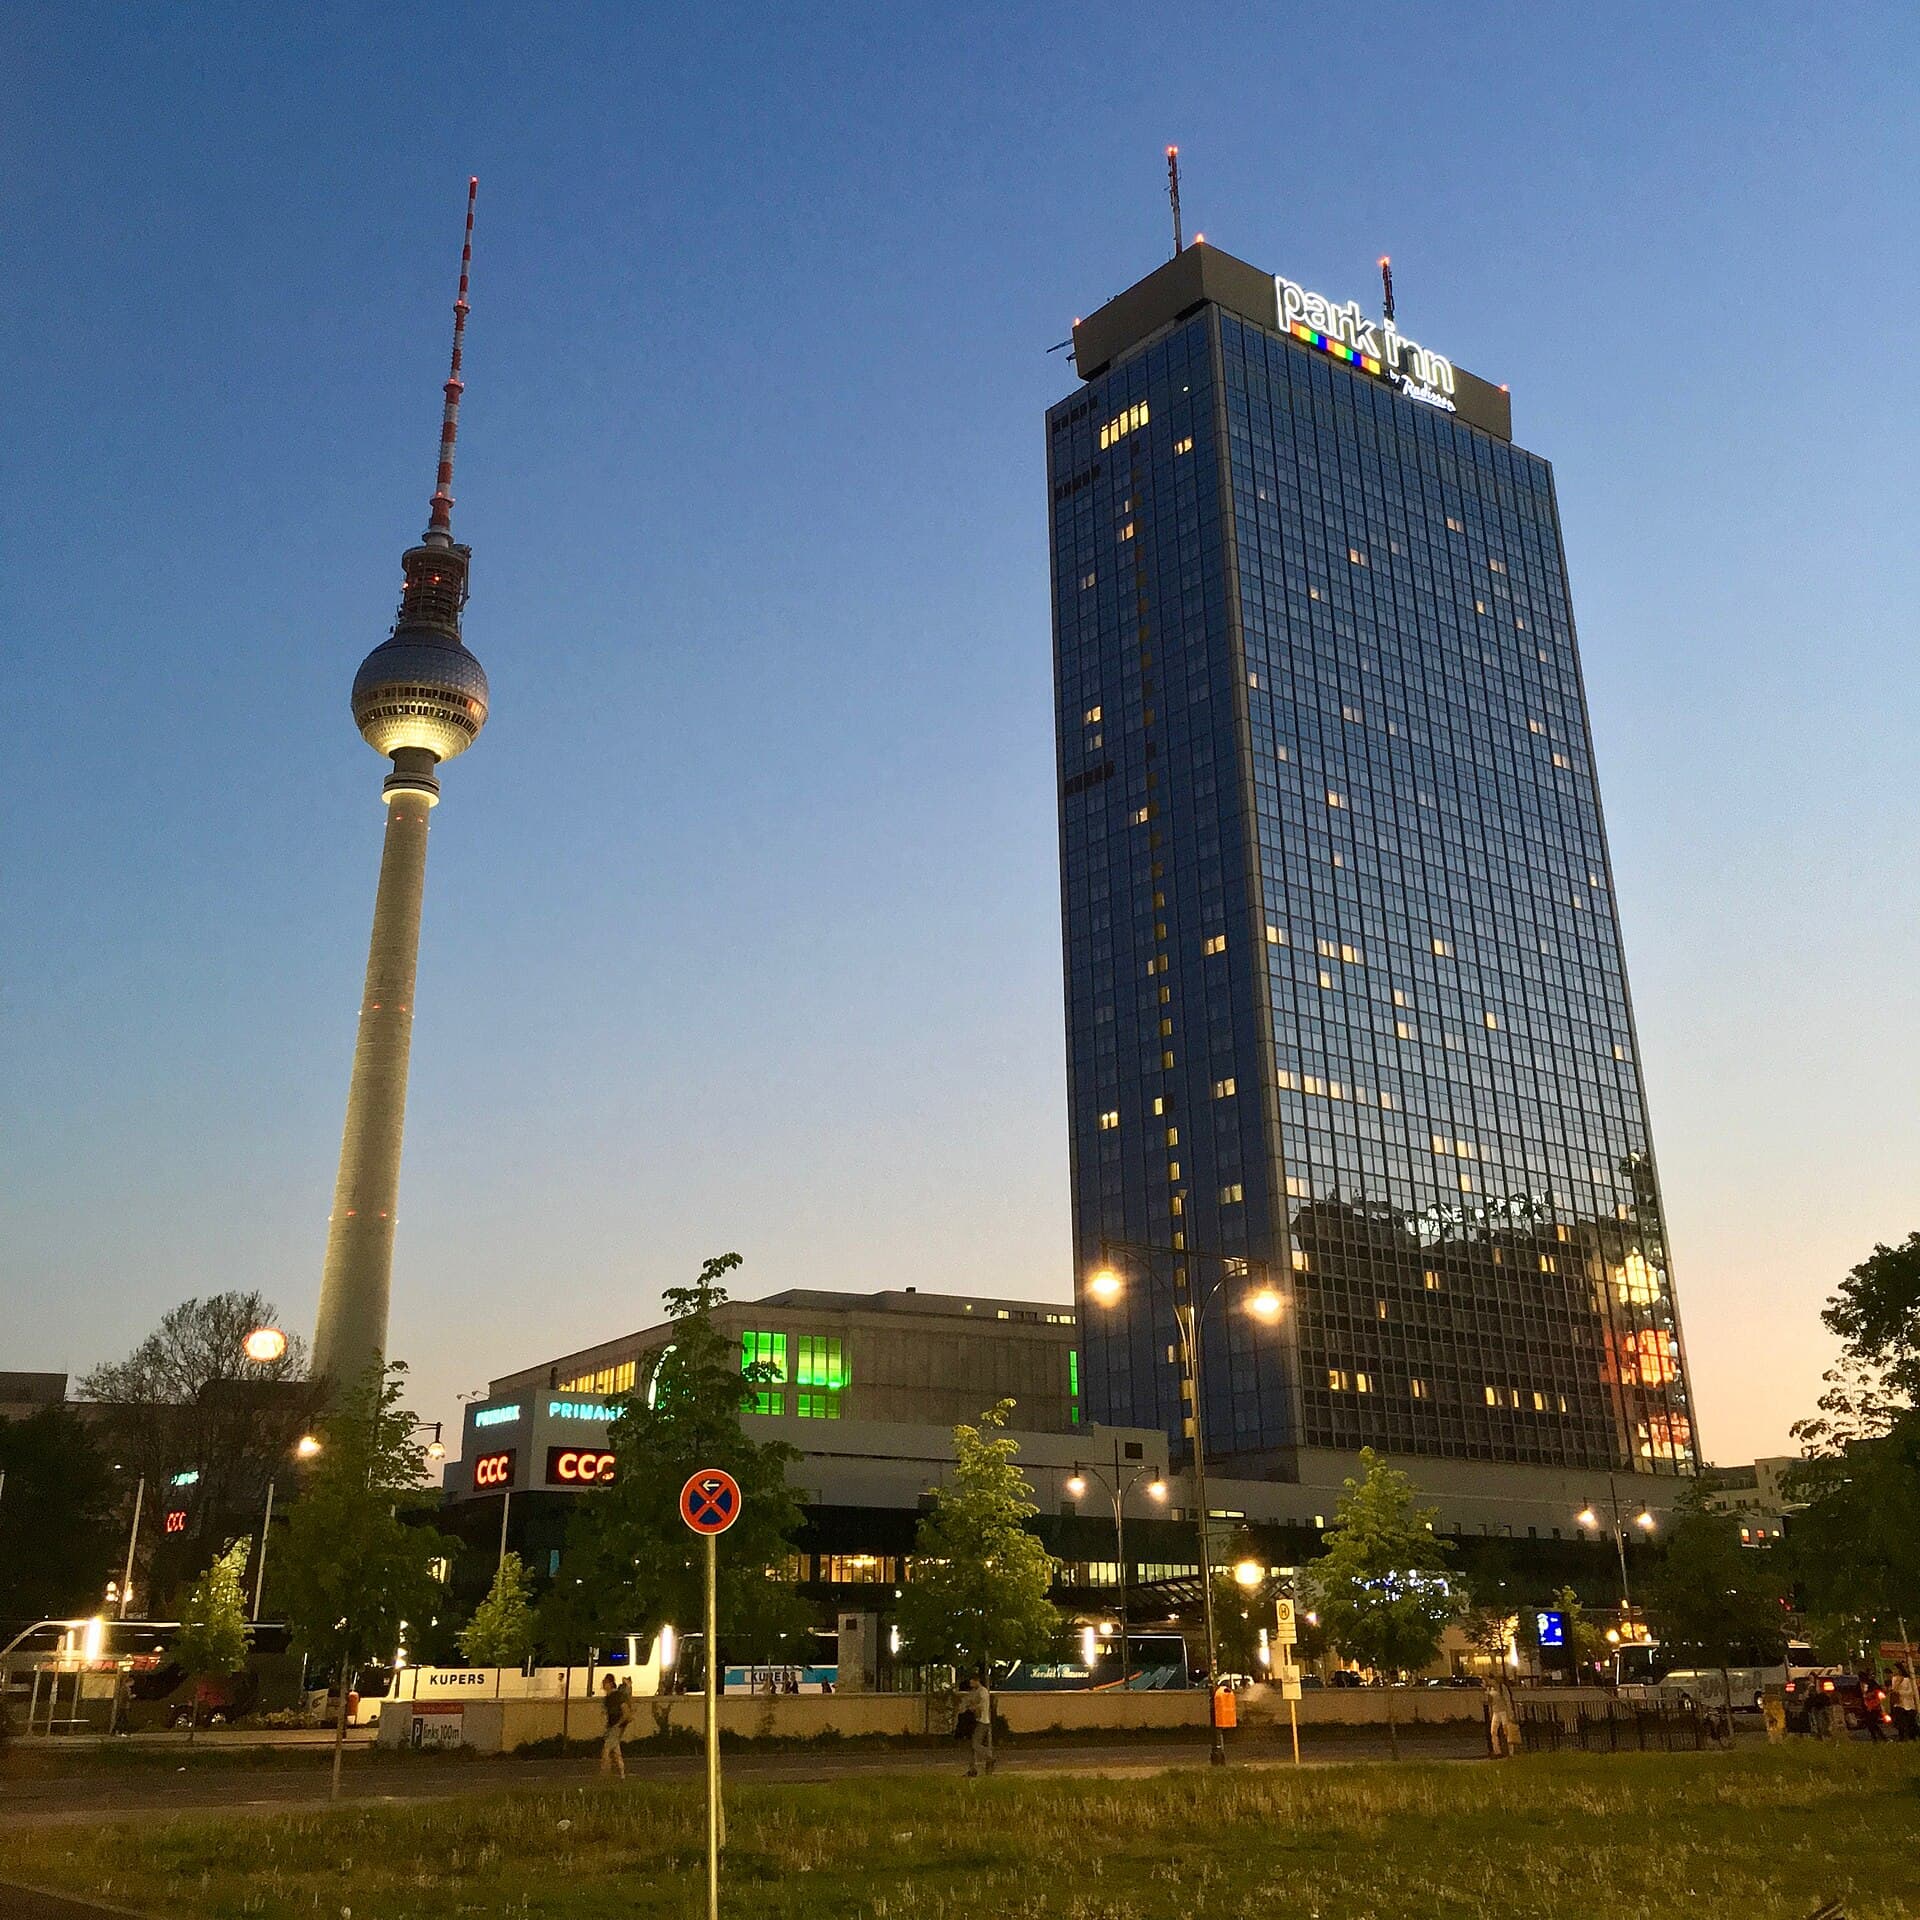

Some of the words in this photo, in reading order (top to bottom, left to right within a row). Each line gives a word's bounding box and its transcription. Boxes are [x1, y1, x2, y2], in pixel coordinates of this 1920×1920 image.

[1275, 275, 1382, 360] park
[1383, 316, 1456, 395] inn
[1401, 373, 1457, 413] Radisson
[477, 1455, 509, 1485] CCC
[430, 1674, 485, 1685] KUPERS
